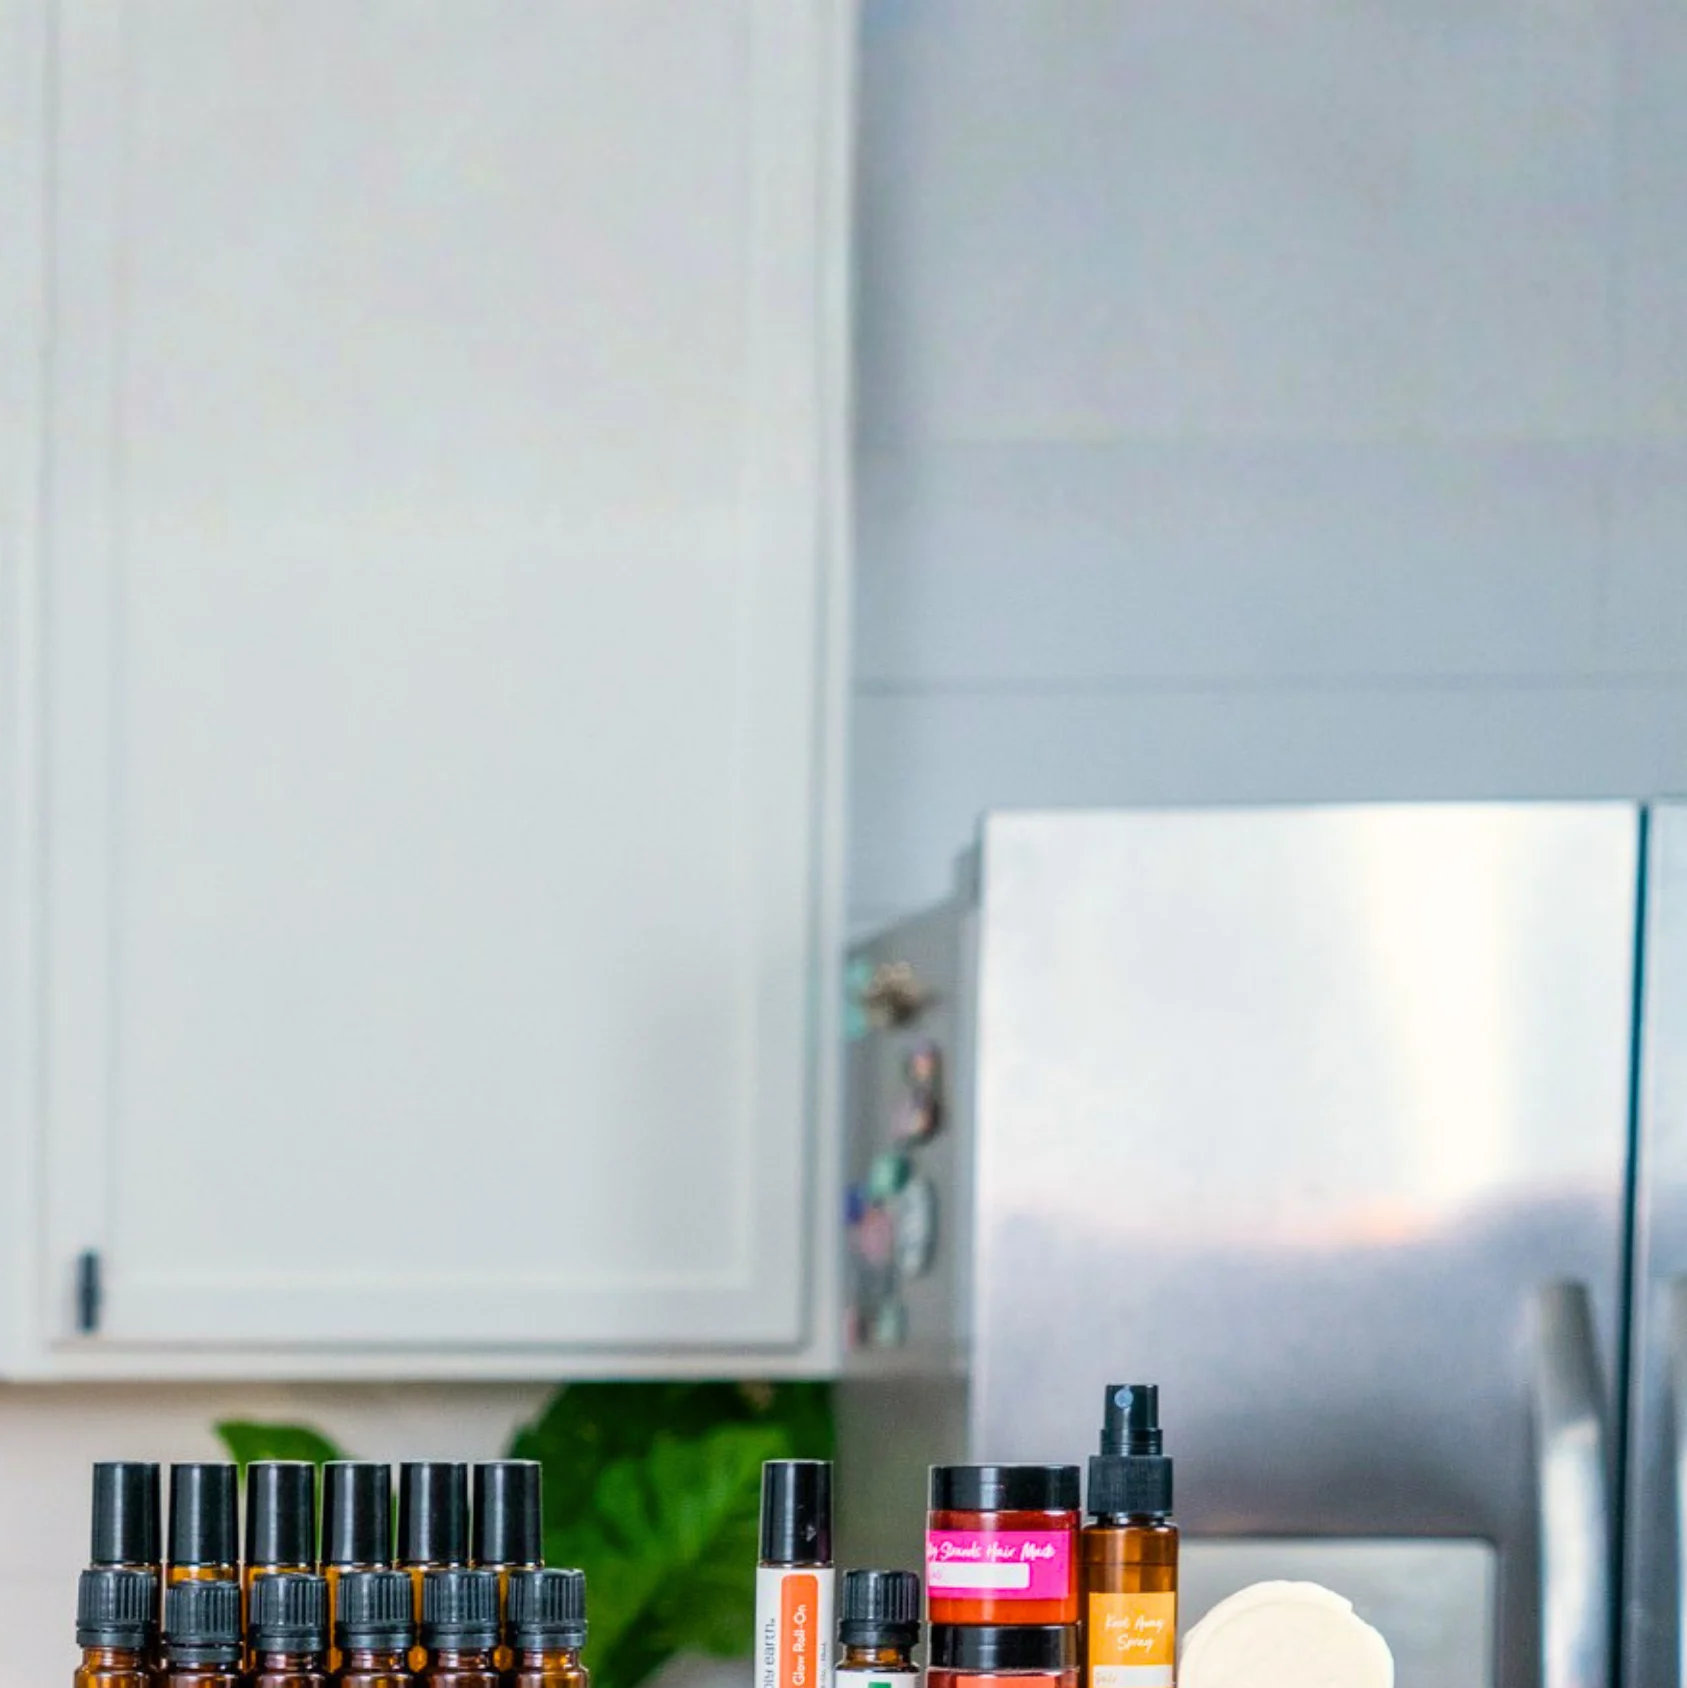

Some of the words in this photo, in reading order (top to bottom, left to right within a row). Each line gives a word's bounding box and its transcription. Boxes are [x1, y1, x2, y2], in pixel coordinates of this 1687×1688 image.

[793, 1604, 807, 1653] Roll-On
[1117, 1633, 1155, 1654] Spray
[792, 1656, 806, 1686] Glow
